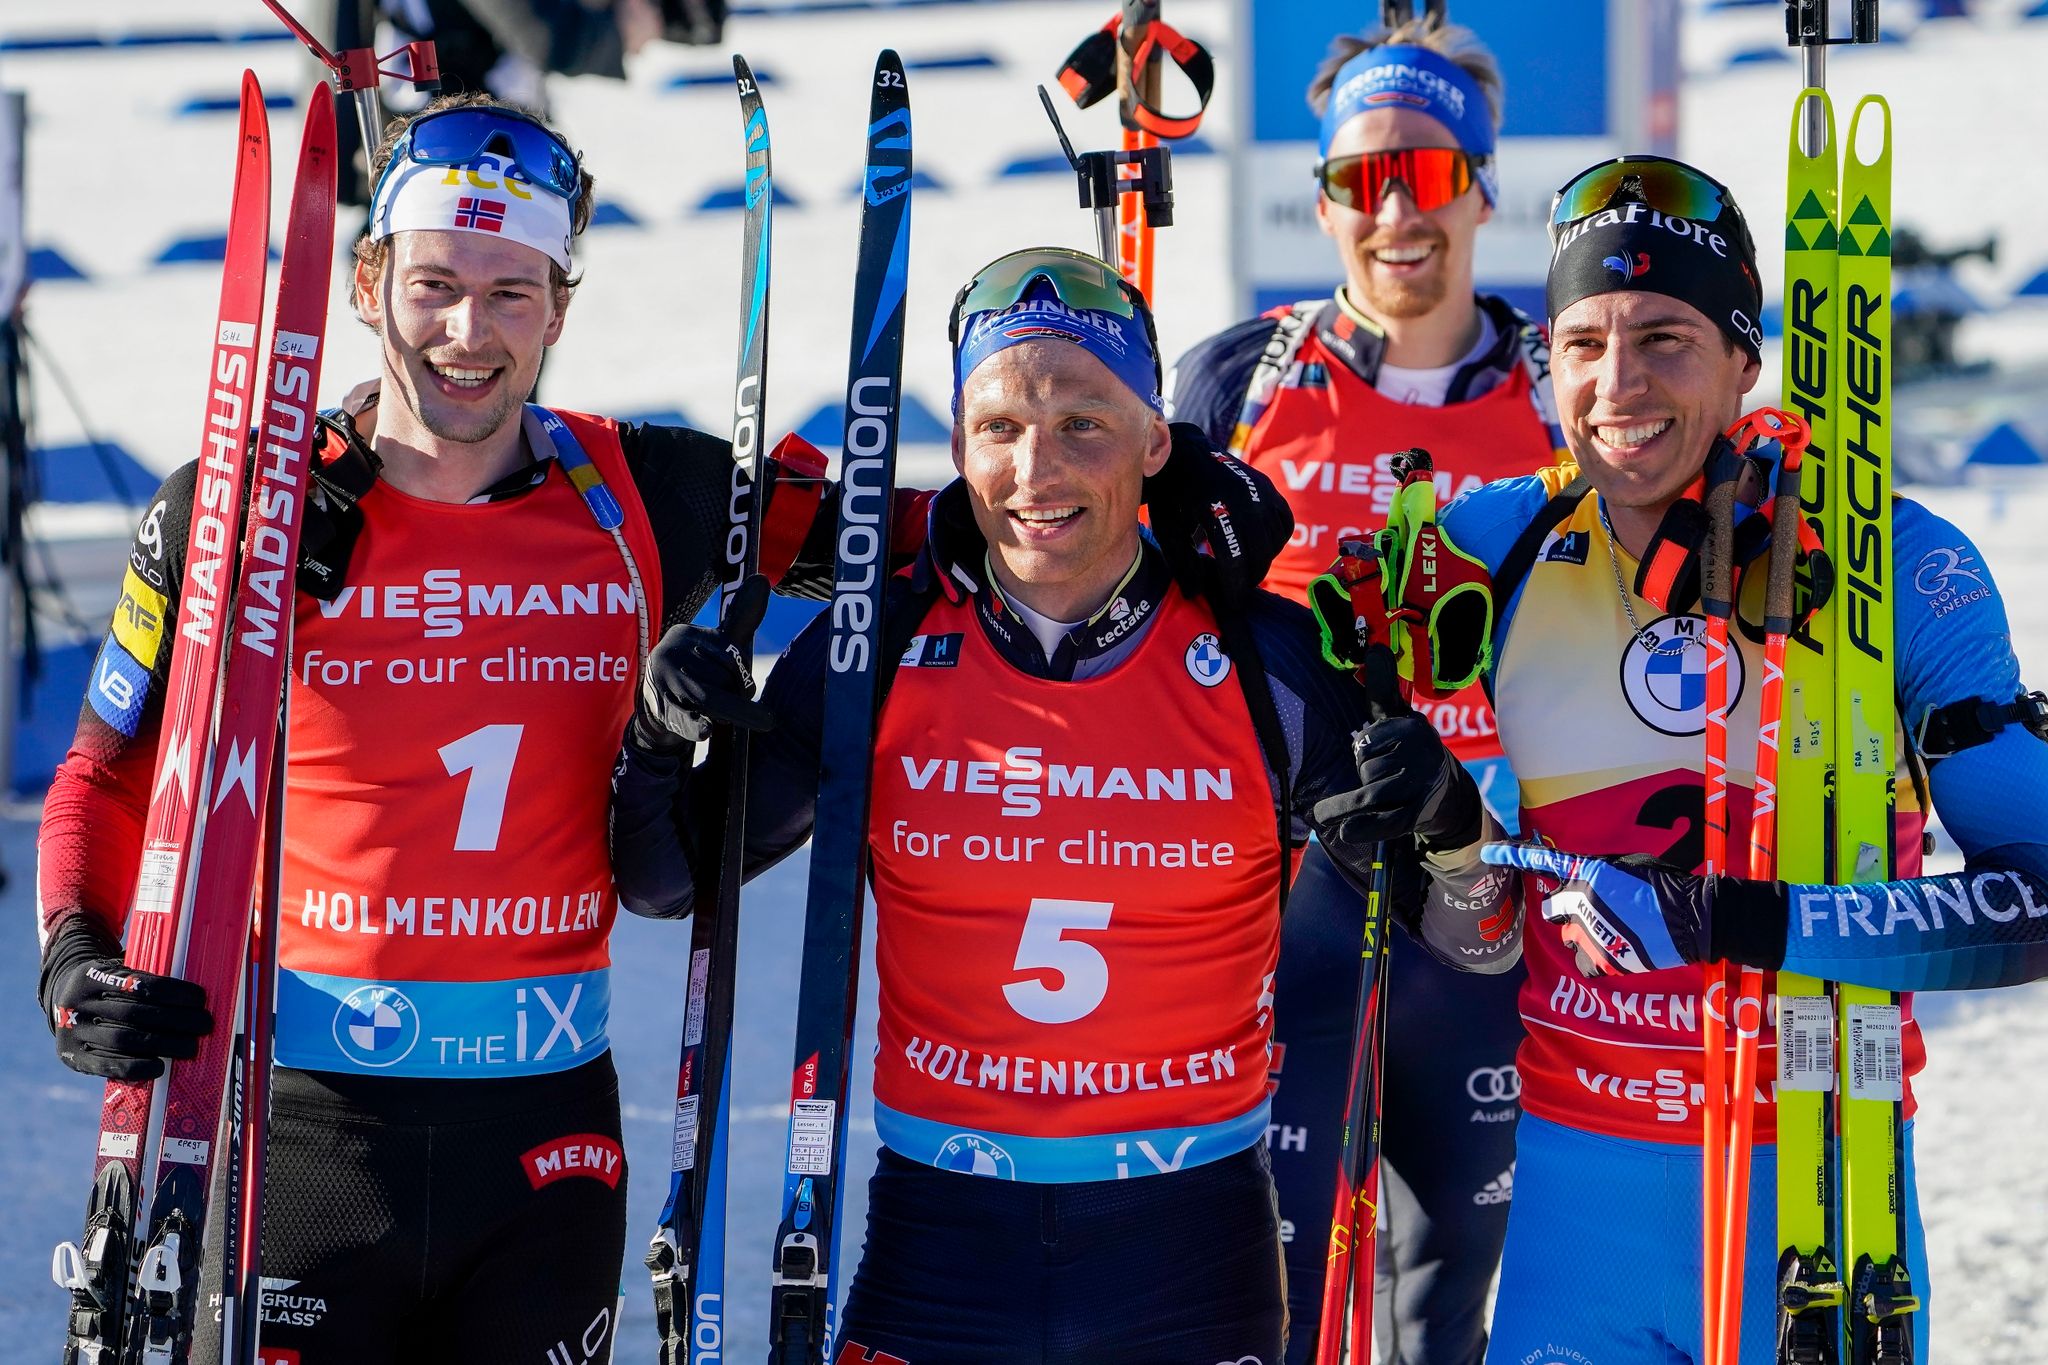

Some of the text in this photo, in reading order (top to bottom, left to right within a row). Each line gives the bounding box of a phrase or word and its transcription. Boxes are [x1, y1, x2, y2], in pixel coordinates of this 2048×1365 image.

[738, 79, 755, 96] 32
[876, 70, 905, 88] 32
[440, 152, 532, 200] ice
[221, 330, 241, 341] SHL
[280, 339, 305, 354] SHL
[1847, 283, 1883, 663] FISCHER
[182, 350, 248, 647] MADSHUS
[241, 361, 311, 658] MADSHUS
[720, 375, 758, 622] alomon
[829, 377, 891, 673] salomon
[1422, 533, 1438, 593] LEKI
[119, 592, 157, 632] AF
[317, 569, 636, 638] VIESSMANN
[1929, 585, 1958, 609] ROY
[1935, 587, 1992, 619] ENERGIE
[1096, 599, 1151, 648] tectake
[98, 657, 134, 711] VB
[302, 647, 629, 685] for our climate
[437, 724, 524, 852] 1
[901, 746, 1234, 817] VIESSMANN
[893, 820, 1236, 868] for our climate
[301, 889, 602, 936] HOLMENKOLLEN
[1800, 871, 2048, 937] FRANCE
[1002, 897, 1114, 1024] 5
[346, 988, 409, 1013] BMW
[431, 983, 583, 1065] THE iX
[905, 1036, 1236, 1096] HOLMENKOLLEN
[1470, 1108, 1516, 1123] Audi
[533, 1145, 618, 1178] MENY
[947, 1137, 1005, 1162] BMW
[1816, 1165, 1824, 1207] speedmax
[1888, 1173, 1896, 1215] speedmax
[228, 1153, 240, 1277] AERODYNAMICS
